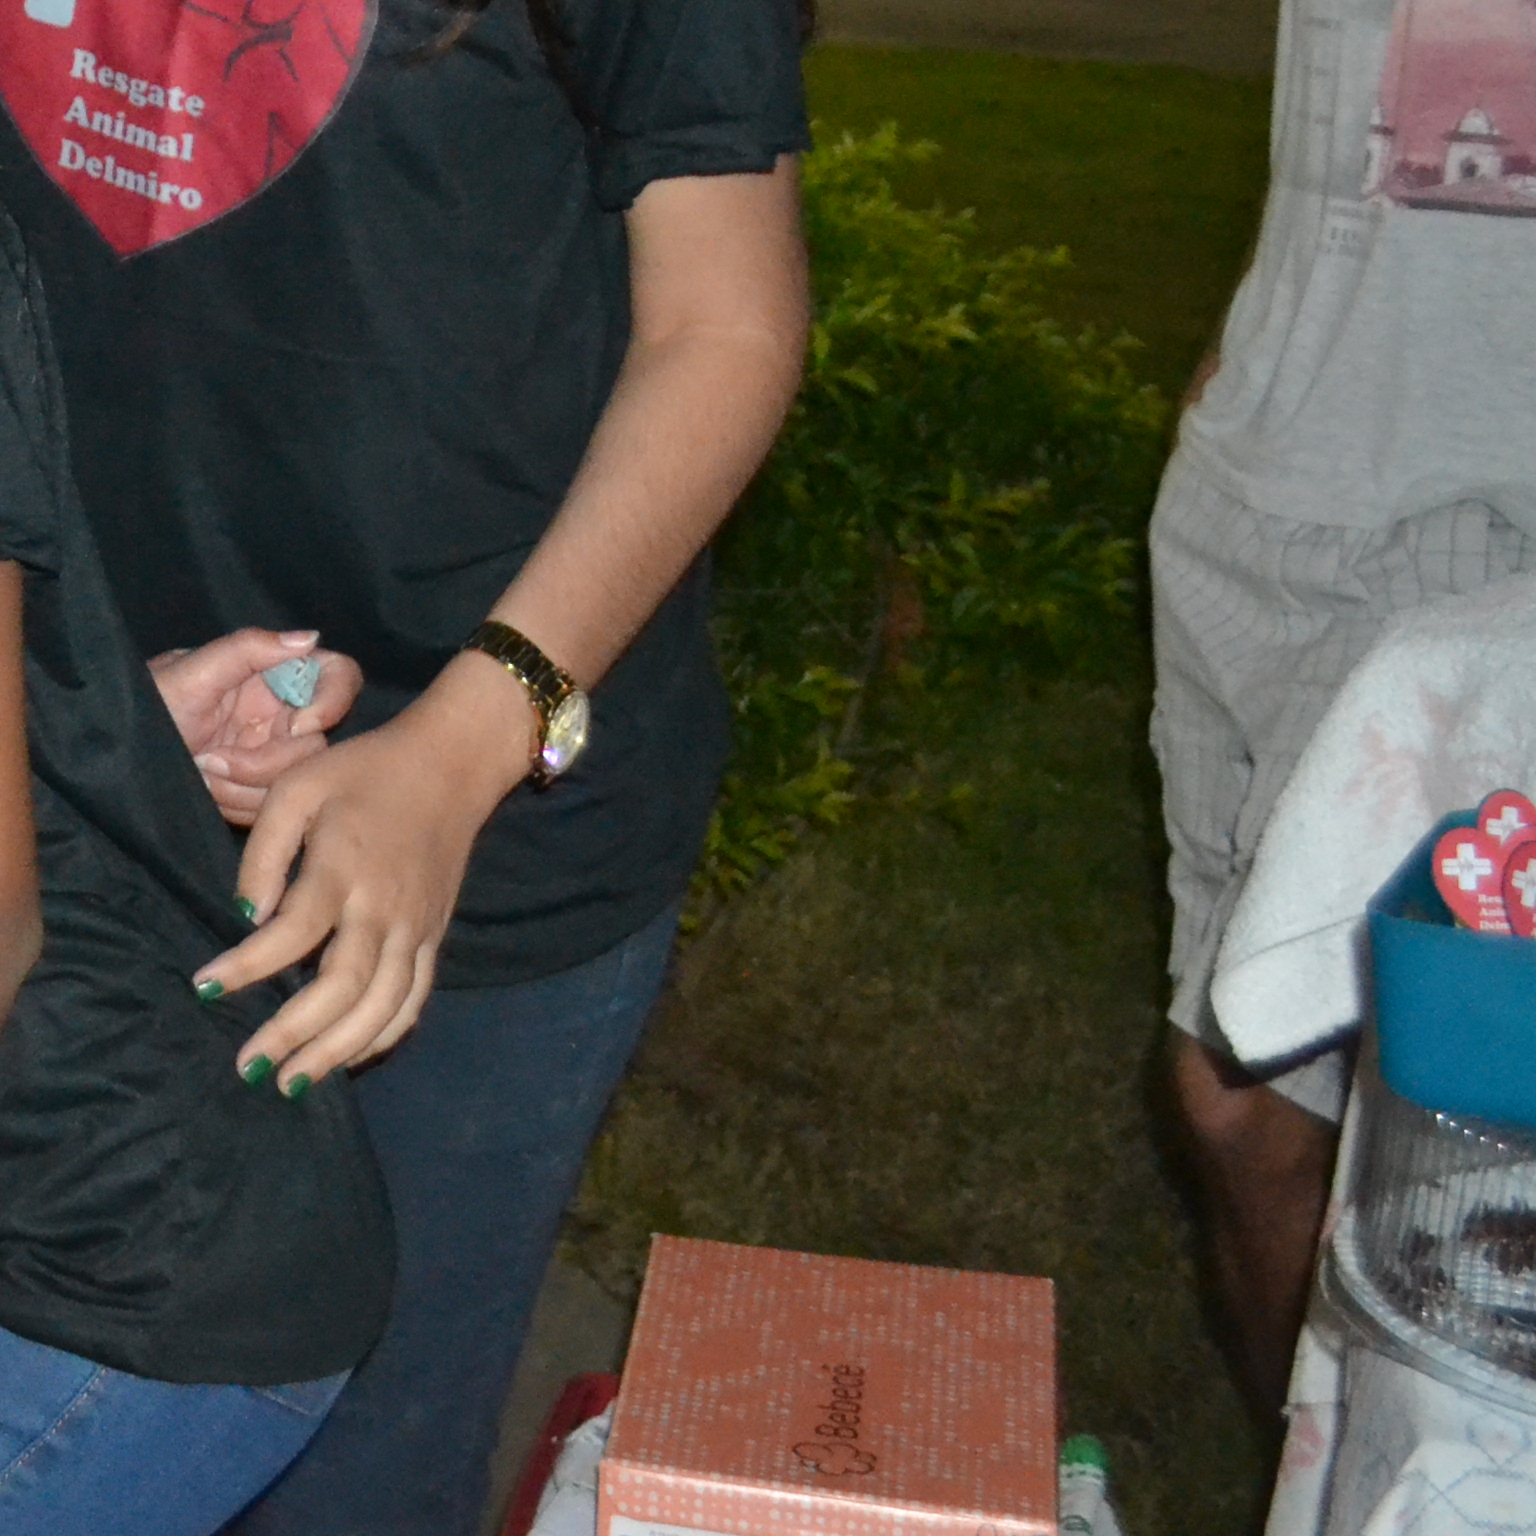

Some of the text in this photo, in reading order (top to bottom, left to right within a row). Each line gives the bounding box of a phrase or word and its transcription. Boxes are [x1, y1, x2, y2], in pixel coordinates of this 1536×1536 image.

[70, 48, 205, 118] Resgate
[64, 96, 194, 162] Animal
[58, 139, 203, 211] Delmiro
